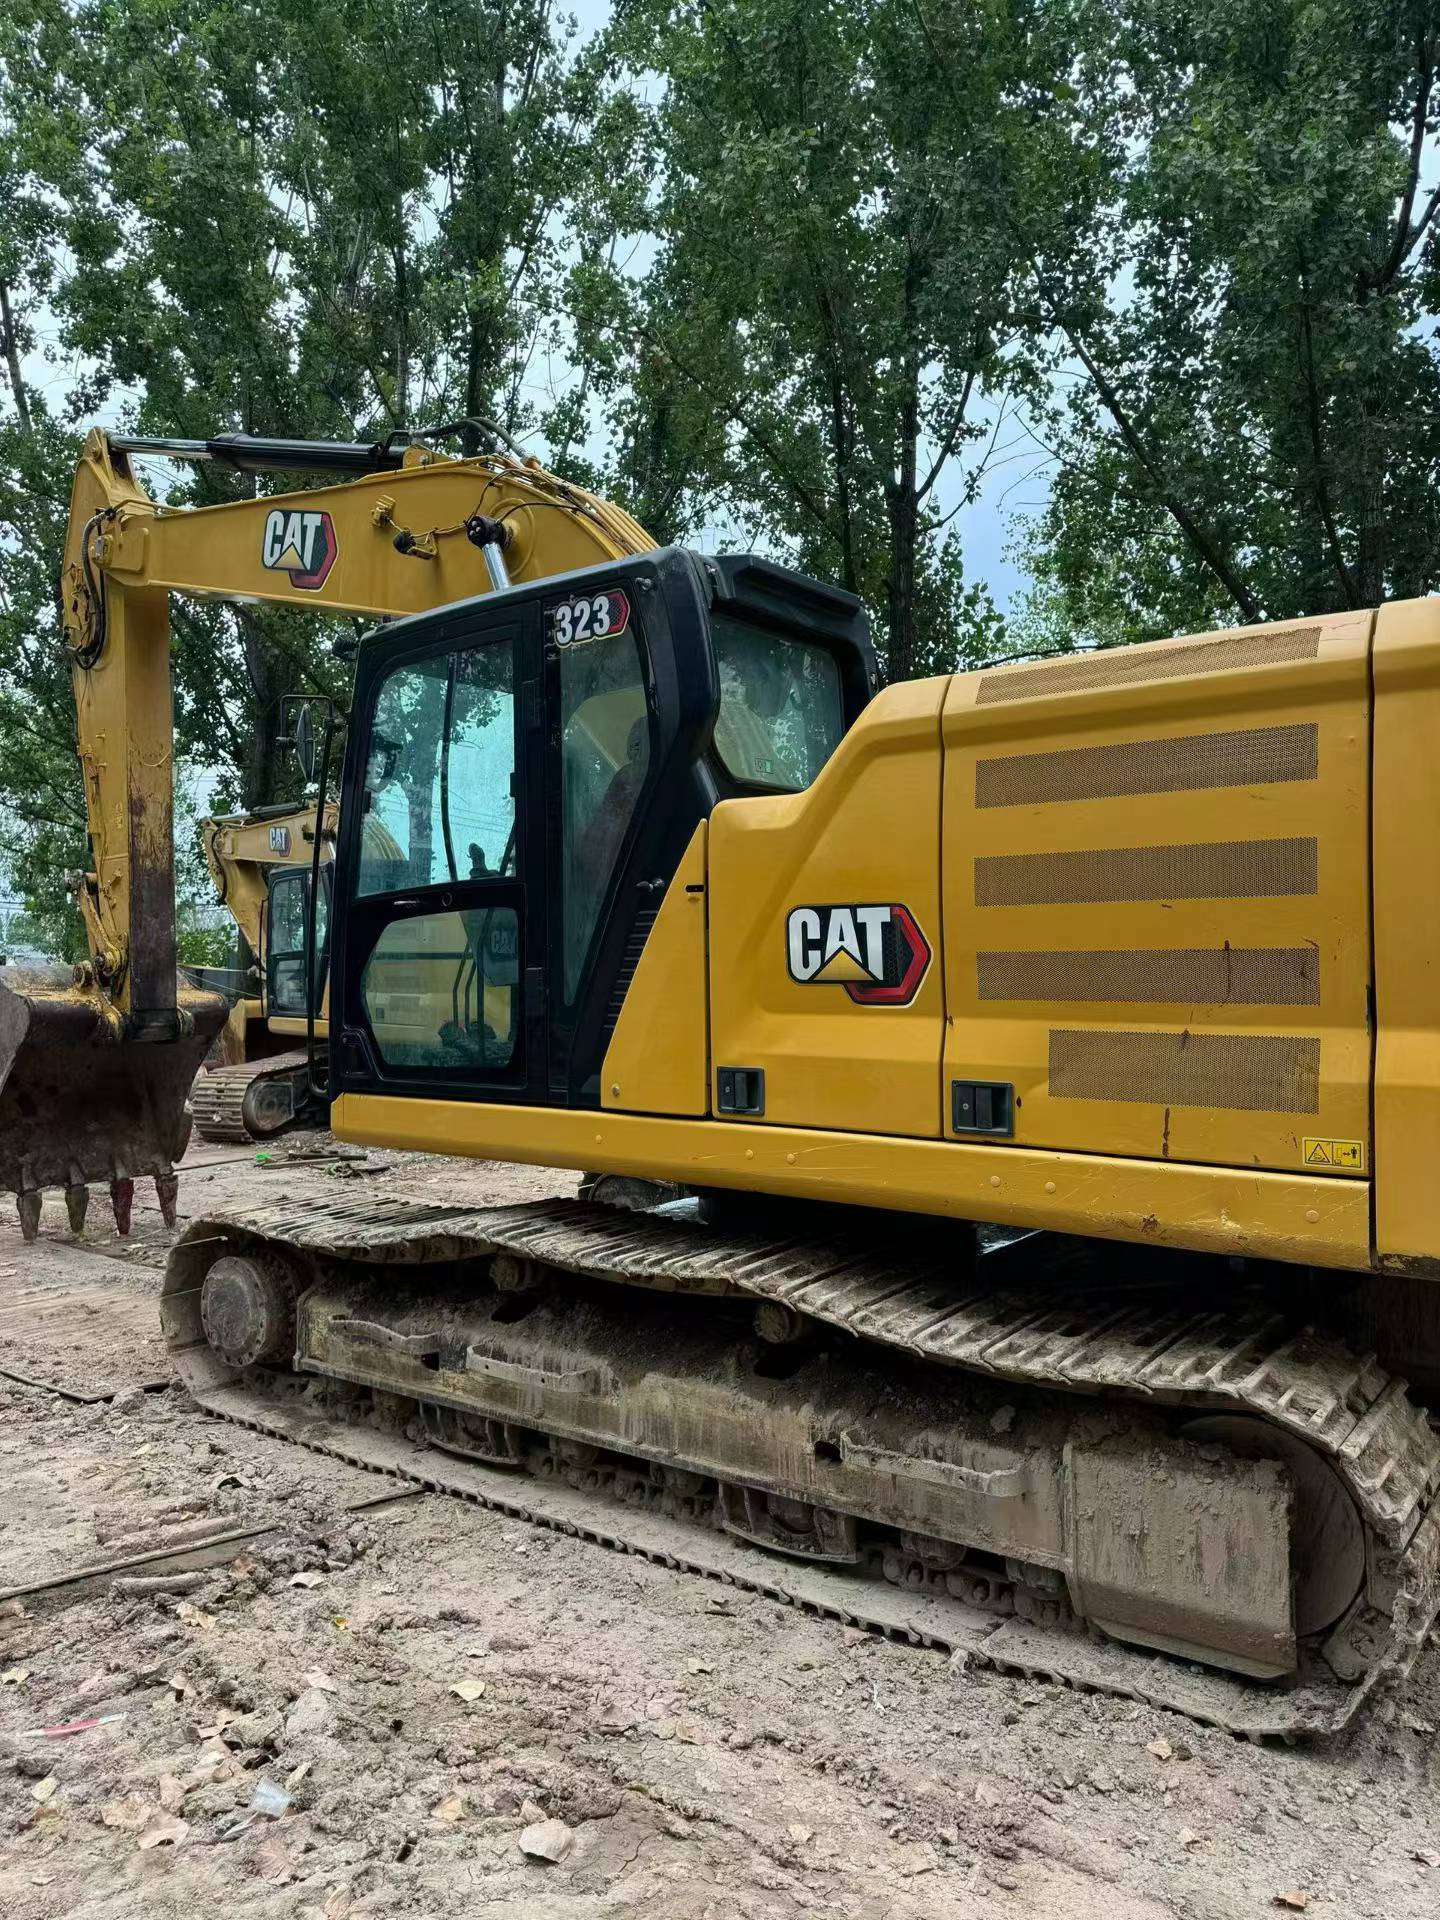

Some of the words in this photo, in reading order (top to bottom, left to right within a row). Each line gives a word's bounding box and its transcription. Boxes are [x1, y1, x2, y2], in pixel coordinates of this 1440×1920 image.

[263, 510, 322, 570] CAT
[556, 595, 610, 644] 323
[270, 827, 287, 851] CAT
[788, 906, 891, 981] CAT
